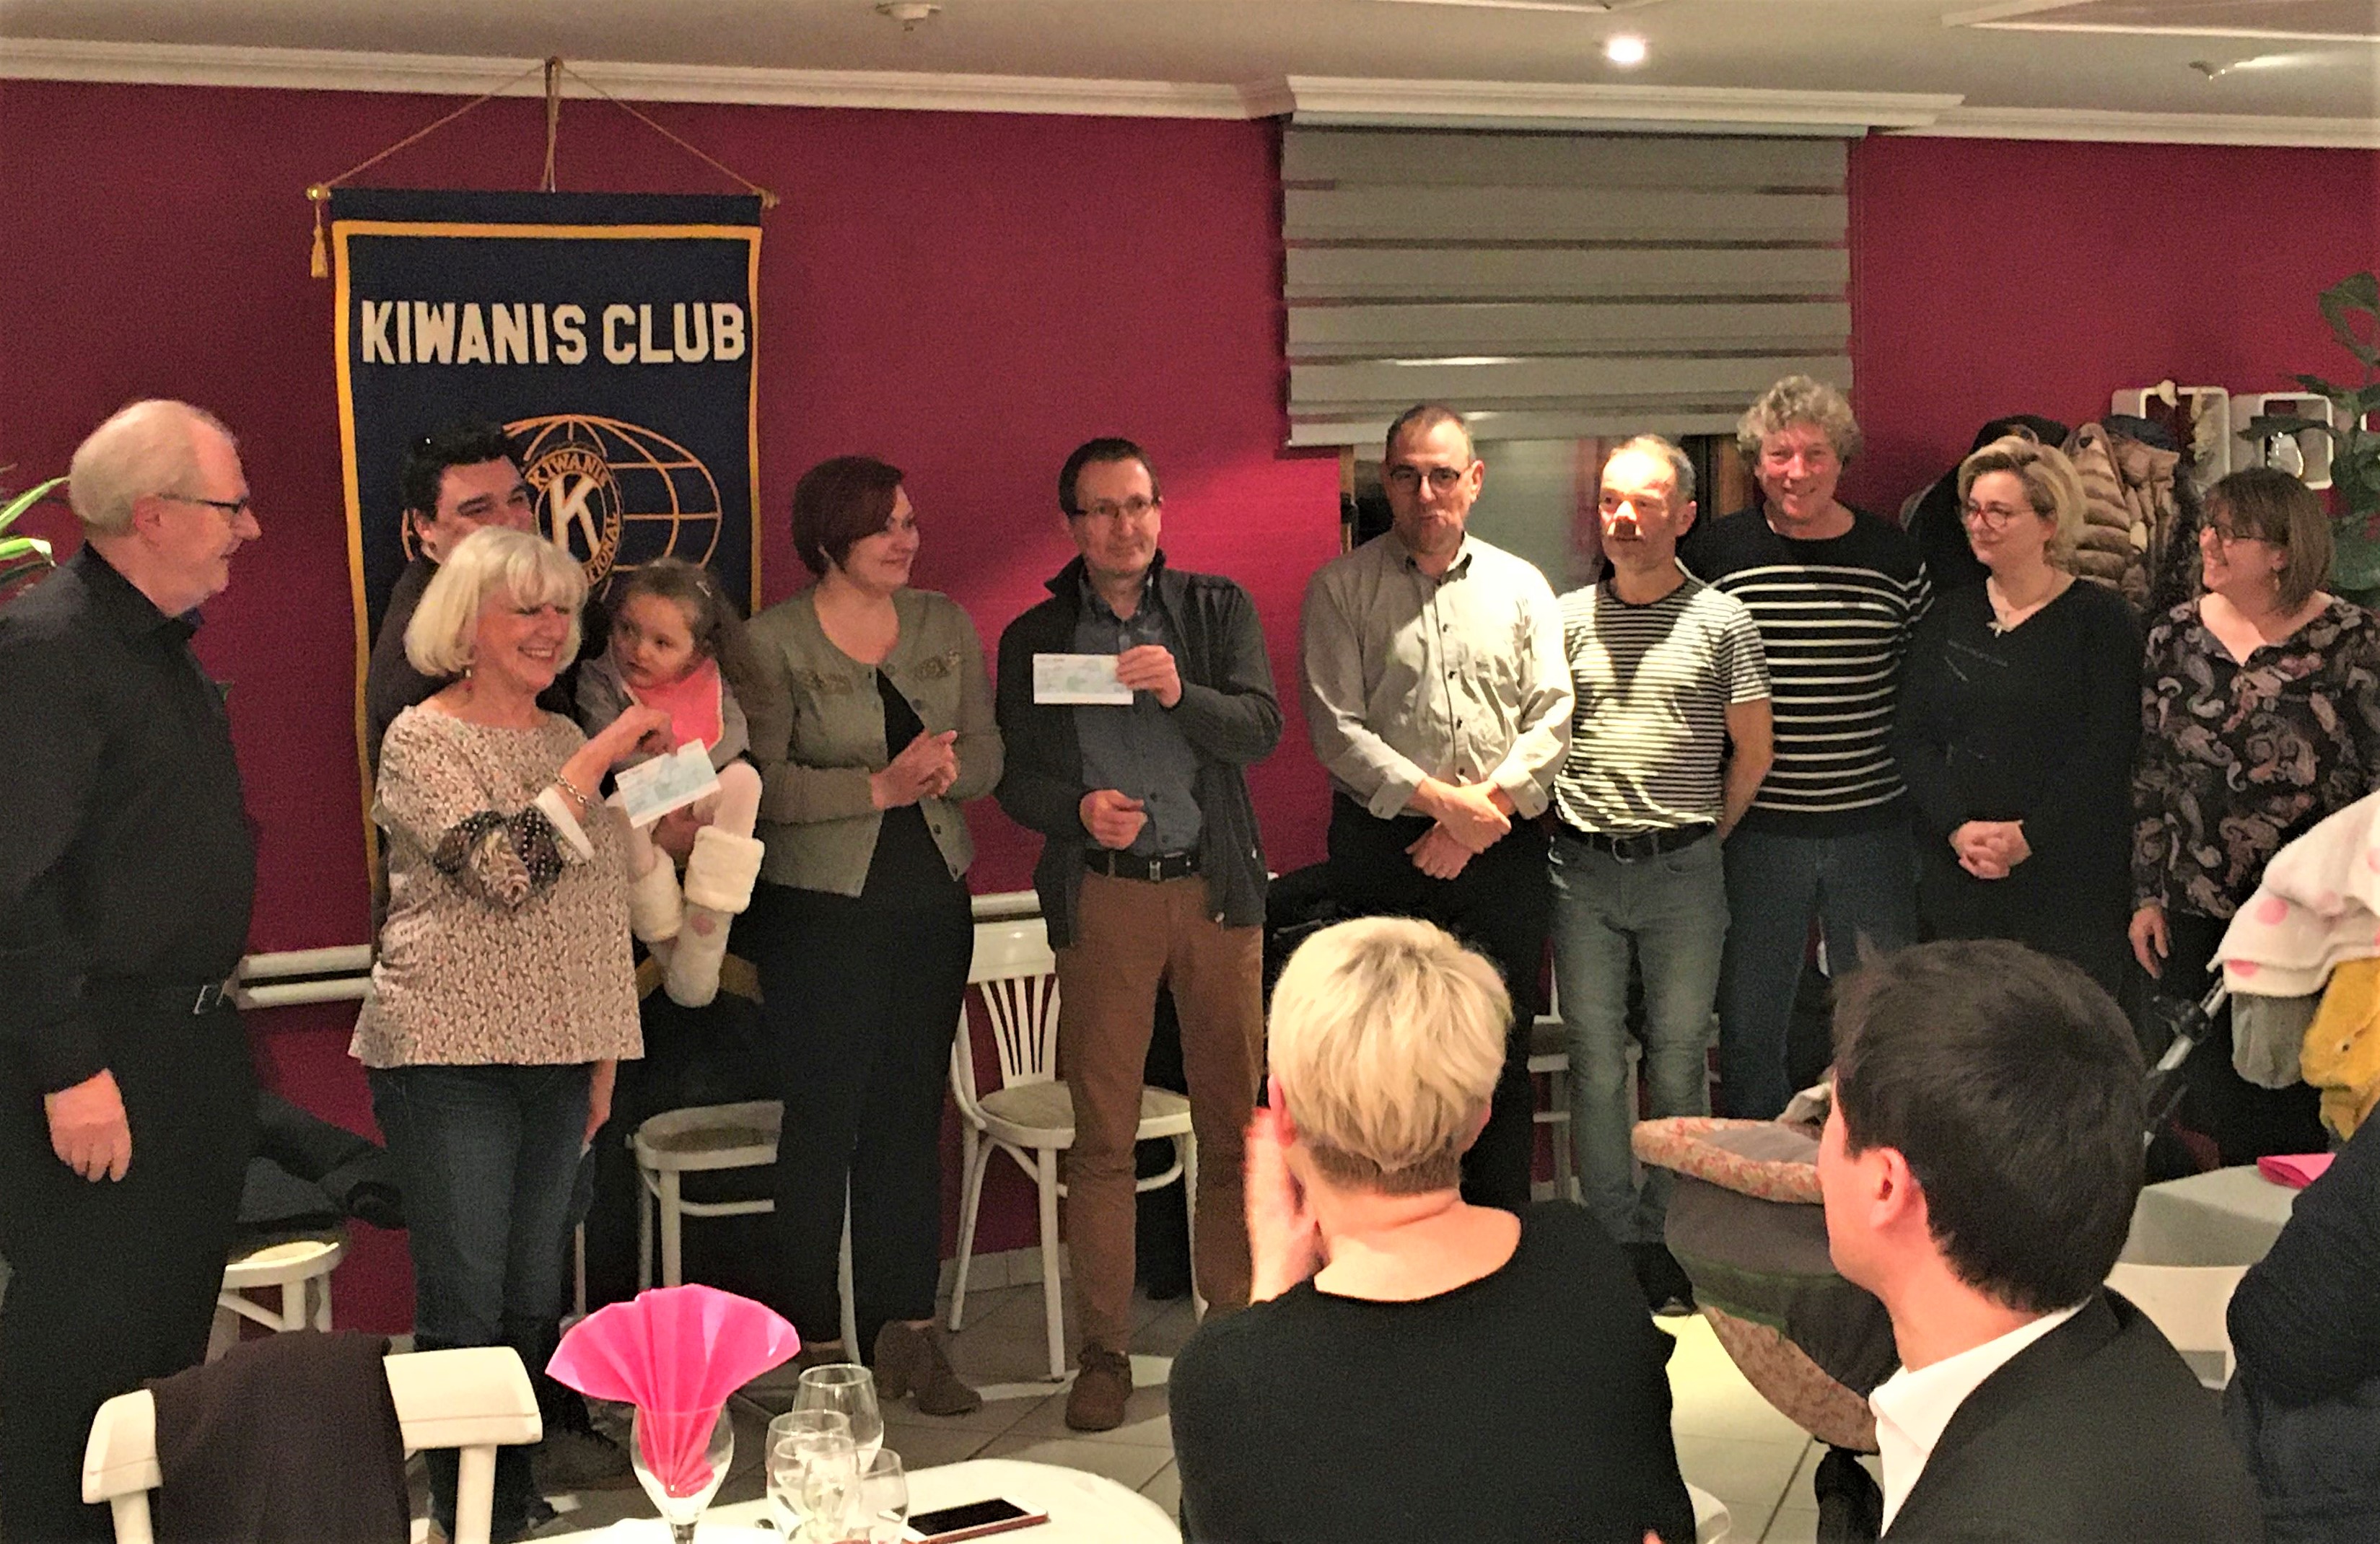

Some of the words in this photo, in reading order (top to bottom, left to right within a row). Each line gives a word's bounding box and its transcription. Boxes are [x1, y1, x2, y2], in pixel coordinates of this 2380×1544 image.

[362, 300, 588, 364] KIWANIS
[603, 302, 745, 364] CLUB
[528, 452, 608, 491] KIWANIS
[549, 470, 602, 563] K
